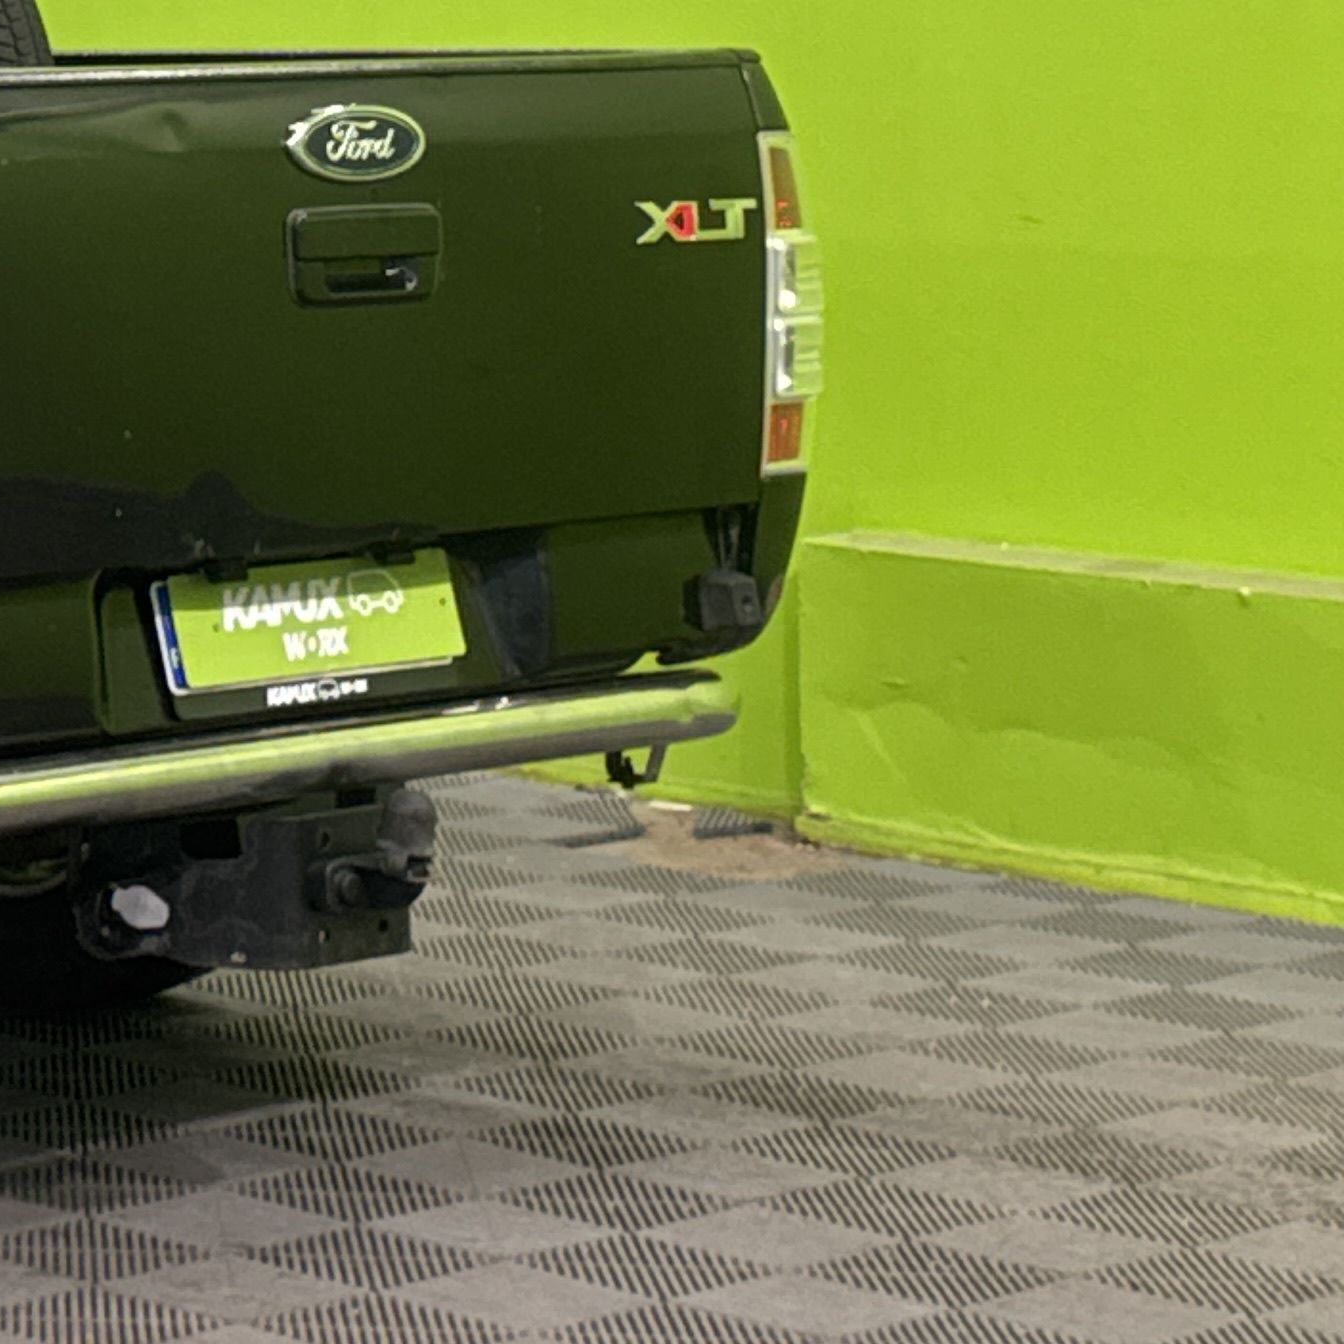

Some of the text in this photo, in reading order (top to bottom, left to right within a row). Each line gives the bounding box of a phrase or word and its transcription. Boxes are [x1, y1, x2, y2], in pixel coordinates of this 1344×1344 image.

[326, 119, 395, 163] Ford
[634, 198, 757, 244] XLT
[222, 577, 344, 633] KAMUX
[282, 626, 349, 662] WORX
